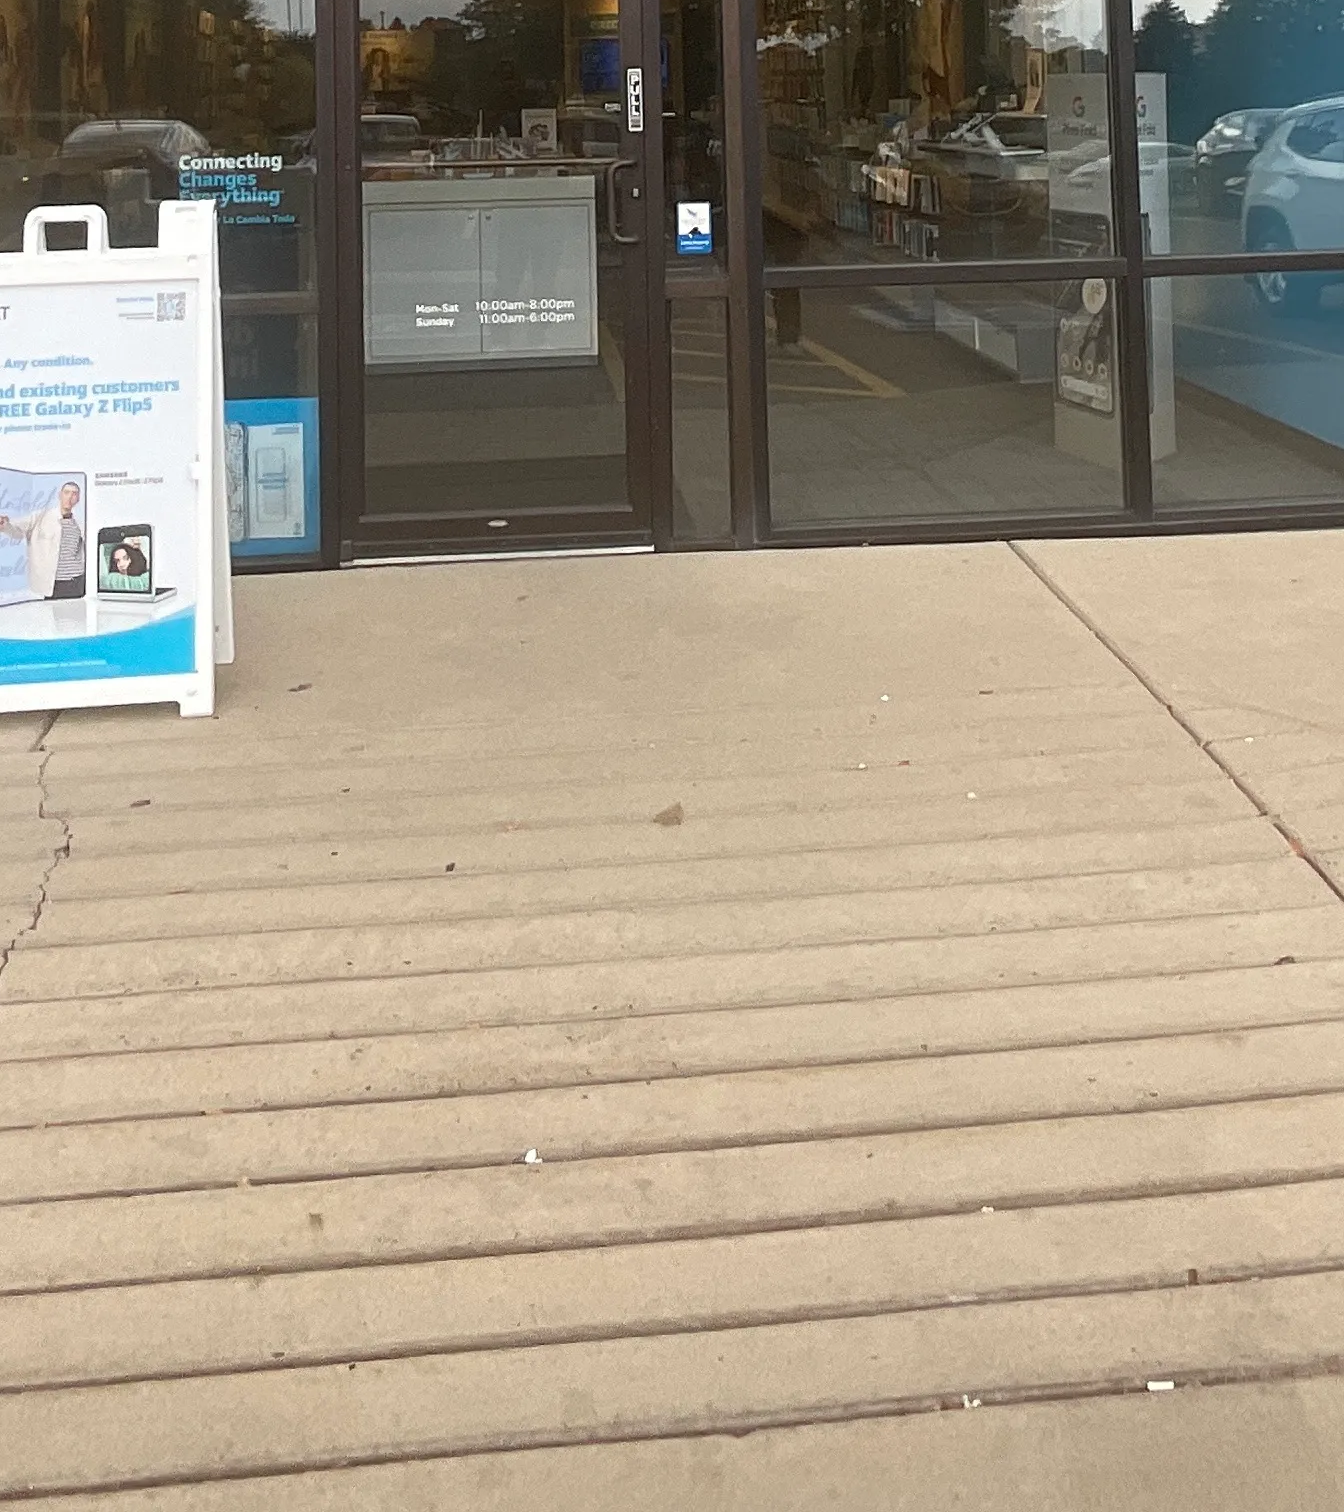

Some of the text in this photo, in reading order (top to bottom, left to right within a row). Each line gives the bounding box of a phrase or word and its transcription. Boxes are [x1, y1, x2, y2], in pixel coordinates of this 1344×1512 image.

[630, 73, 641, 117] PULL
[178, 152, 283, 172] Connecting
[179, 171, 257, 191] Changes
[179, 187, 282, 208] Everything
[415, 298, 575, 314] Mon-Sat 10:00am-8:00pm
[415, 312, 575, 328] Sunday 11:00am-6:00pm
[4, 358, 29, 371] Any
[31, 354, 94, 368] condition.
[19, 382, 88, 401] existing
[92, 379, 180, 395] customers
[35, 400, 94, 419] Galaxy
[97, 399, 109, 414] Z
